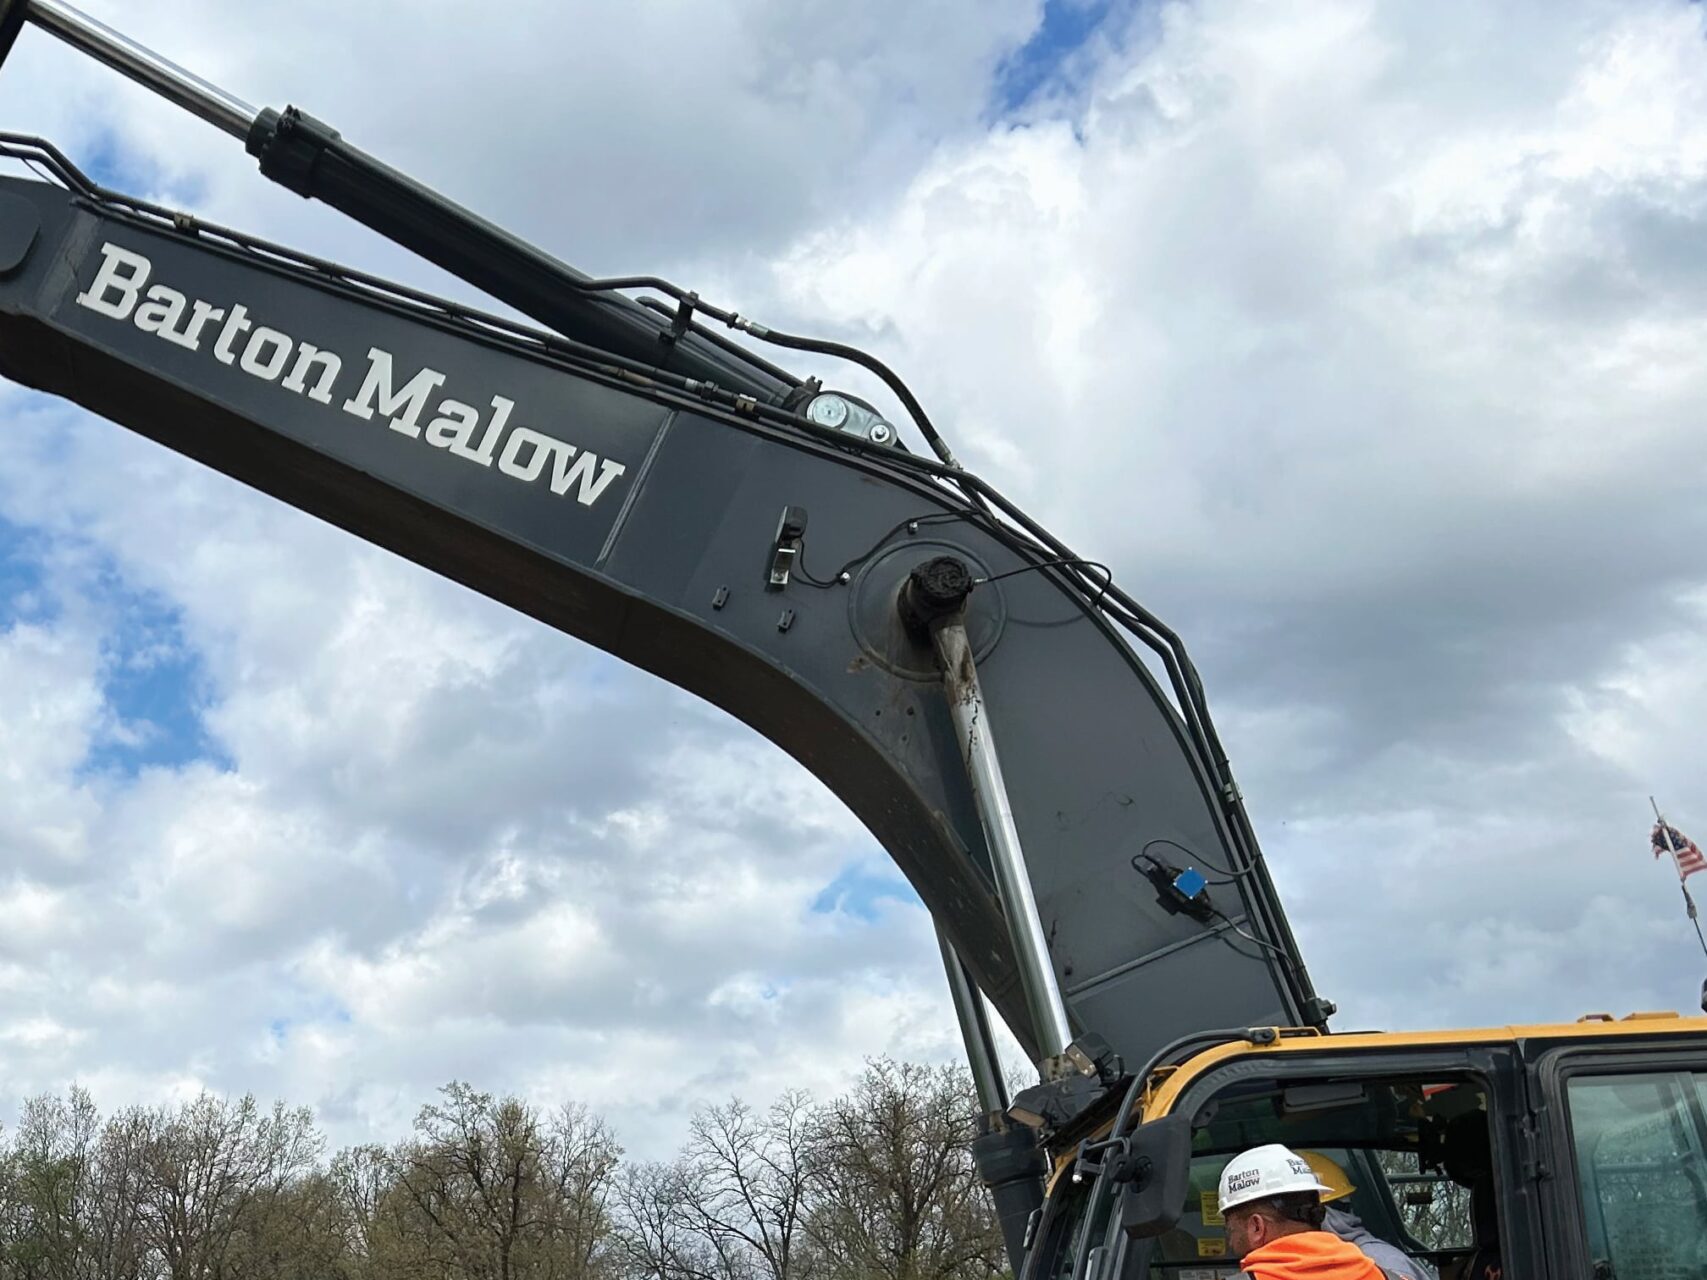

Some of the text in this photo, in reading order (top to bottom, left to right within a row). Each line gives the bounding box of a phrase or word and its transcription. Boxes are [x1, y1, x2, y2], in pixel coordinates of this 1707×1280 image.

[76, 242, 626, 506] Barton Malow
[1228, 1168, 1260, 1184] Barton
[1228, 1177, 1260, 1194] Malow
